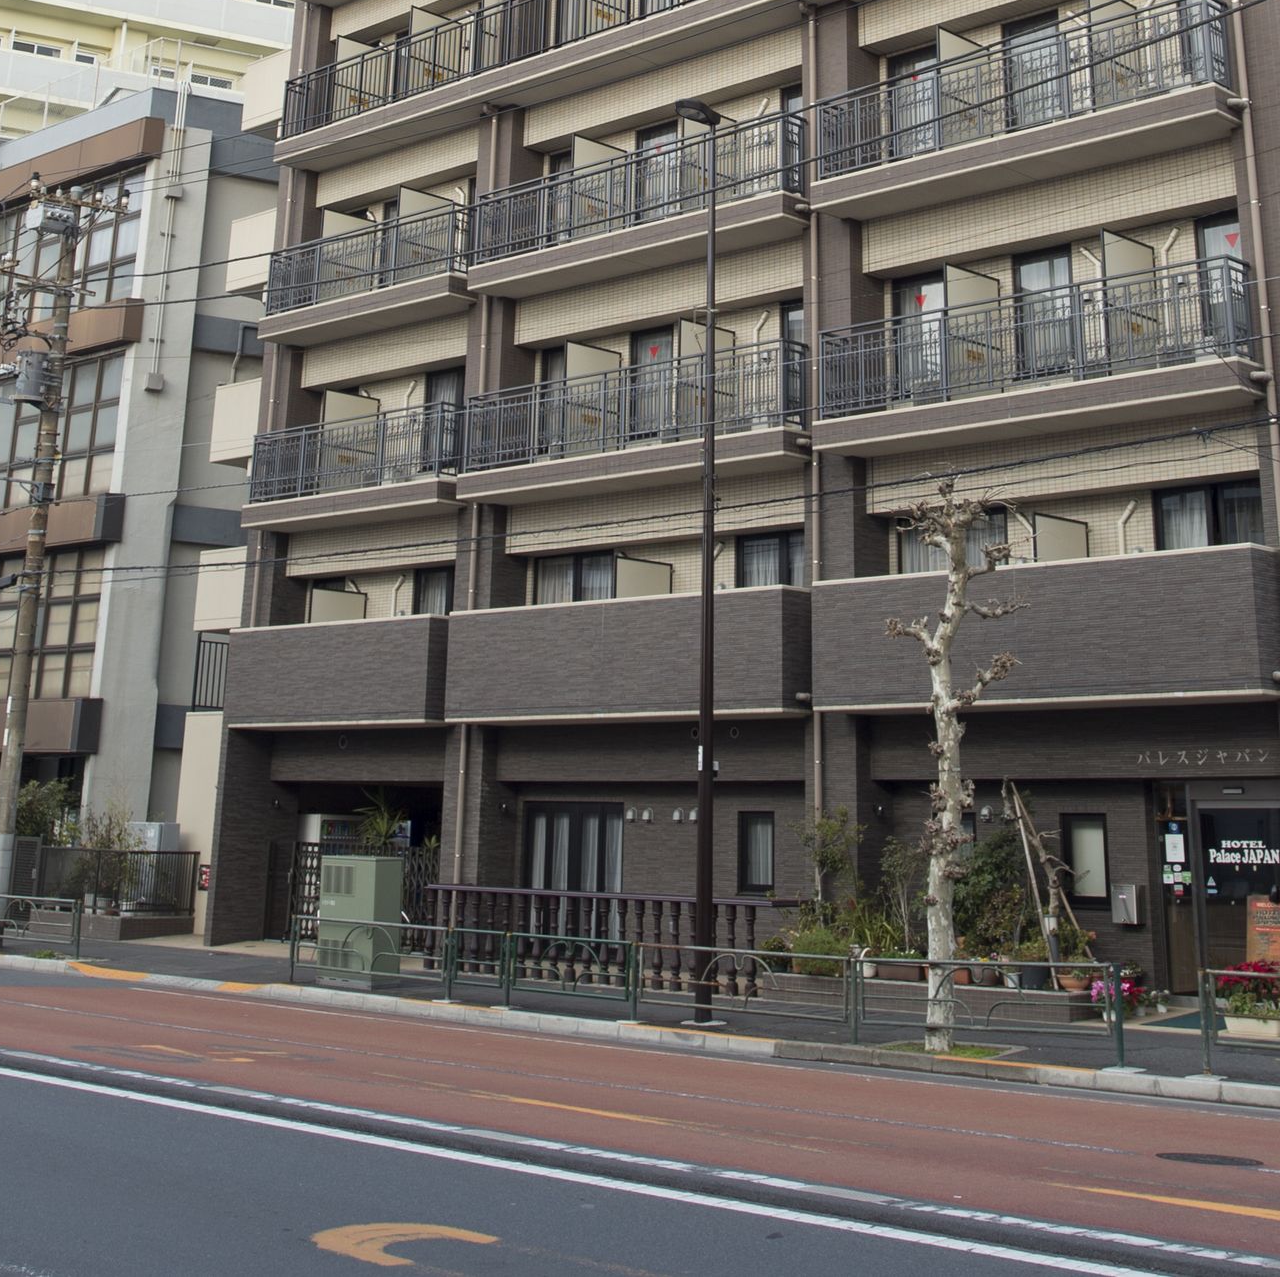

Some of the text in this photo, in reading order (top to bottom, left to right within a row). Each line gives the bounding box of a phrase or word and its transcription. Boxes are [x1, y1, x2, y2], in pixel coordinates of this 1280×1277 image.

[1136, 748, 1271, 767] パレスジャパン
[1221, 840, 1267, 849] HOTEL
[1209, 848, 1280, 864] Palace JAPAN
